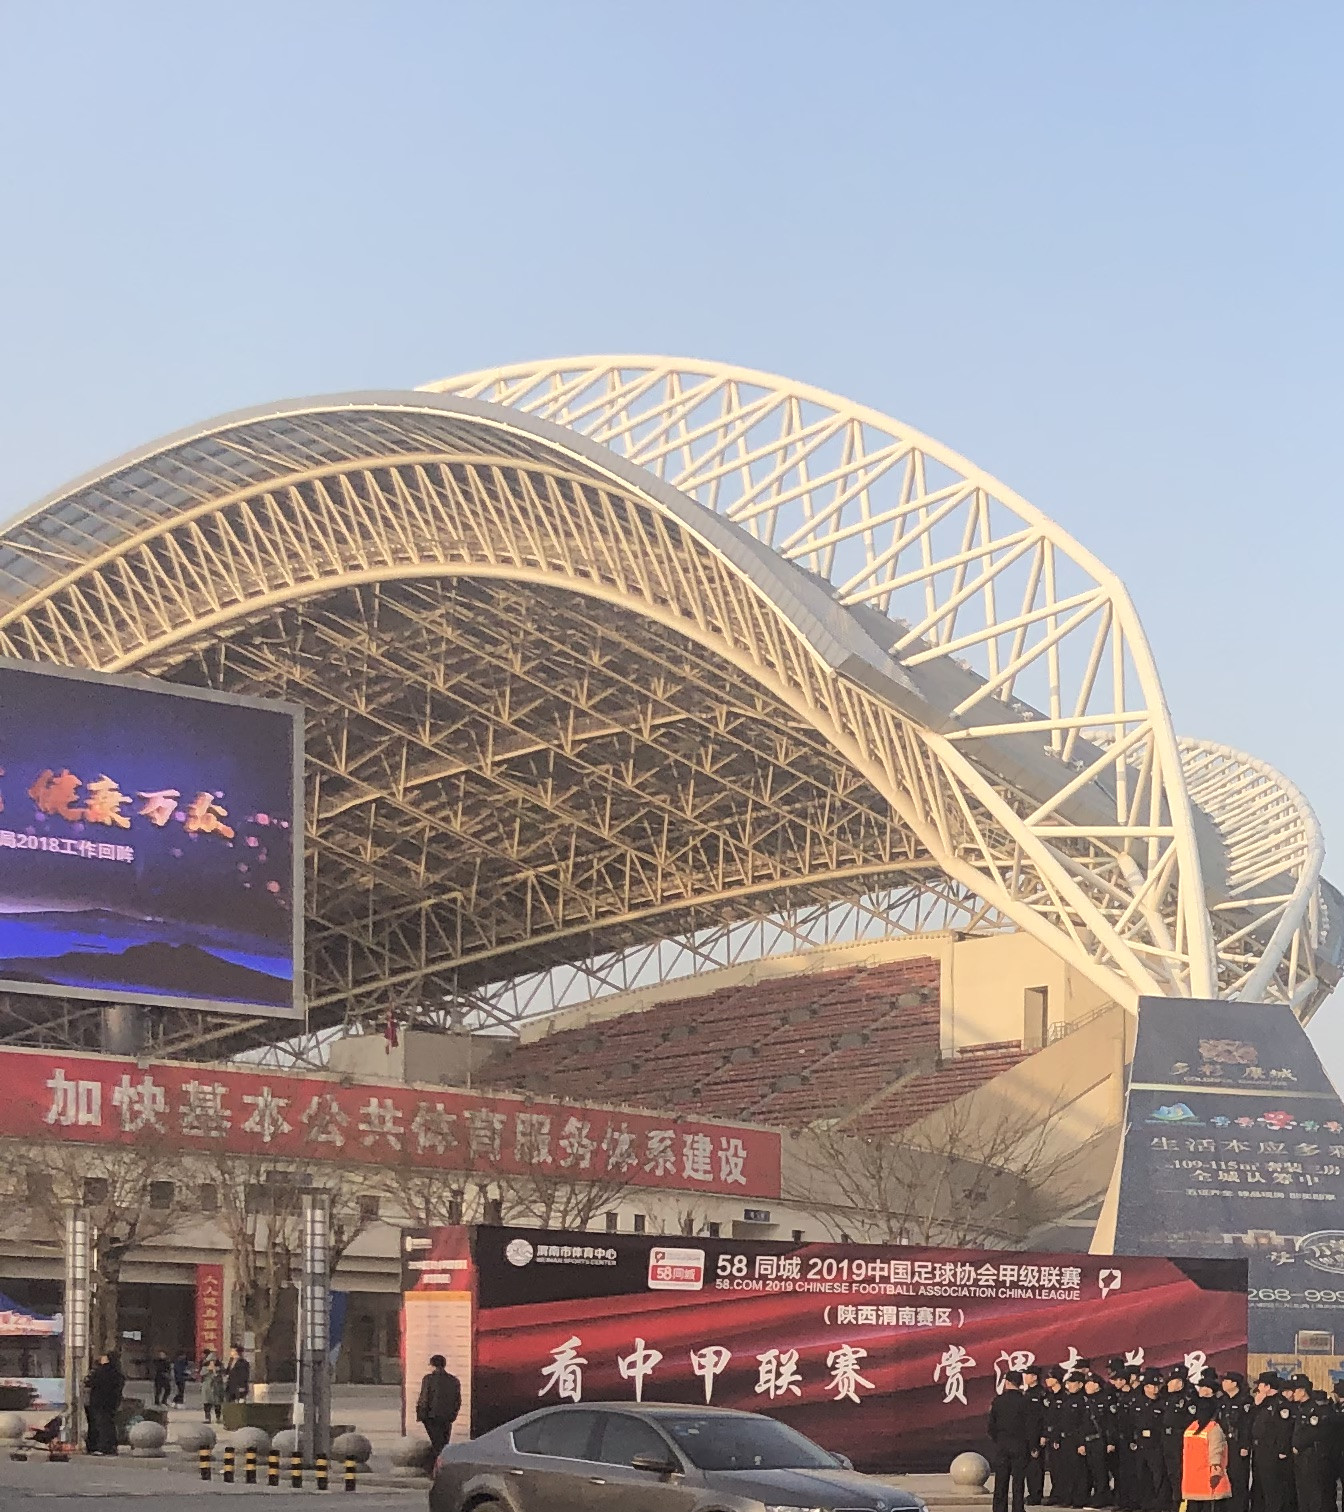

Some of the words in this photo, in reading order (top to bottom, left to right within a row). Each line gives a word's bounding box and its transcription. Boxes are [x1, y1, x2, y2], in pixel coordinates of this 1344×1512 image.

[44, 1068, 748, 1186] 加快基本公共体育服务体系建设
[715, 1278, 763, 1291] 58.COM
[765, 1280, 794, 1292] 2019
[795, 1281, 849, 1294] CHINESE
[852, 1283, 916, 1296] FOOTBALL
[918, 1285, 996, 1298] ASSOCIATION
[998, 1288, 1034, 1299] CHINA
[1036, 1289, 1081, 1301] LEAGUE
[806, 1257, 1082, 1289] 2019中国足球协会甲级联赛
[538, 1335, 877, 1405] 看中甲联赛
